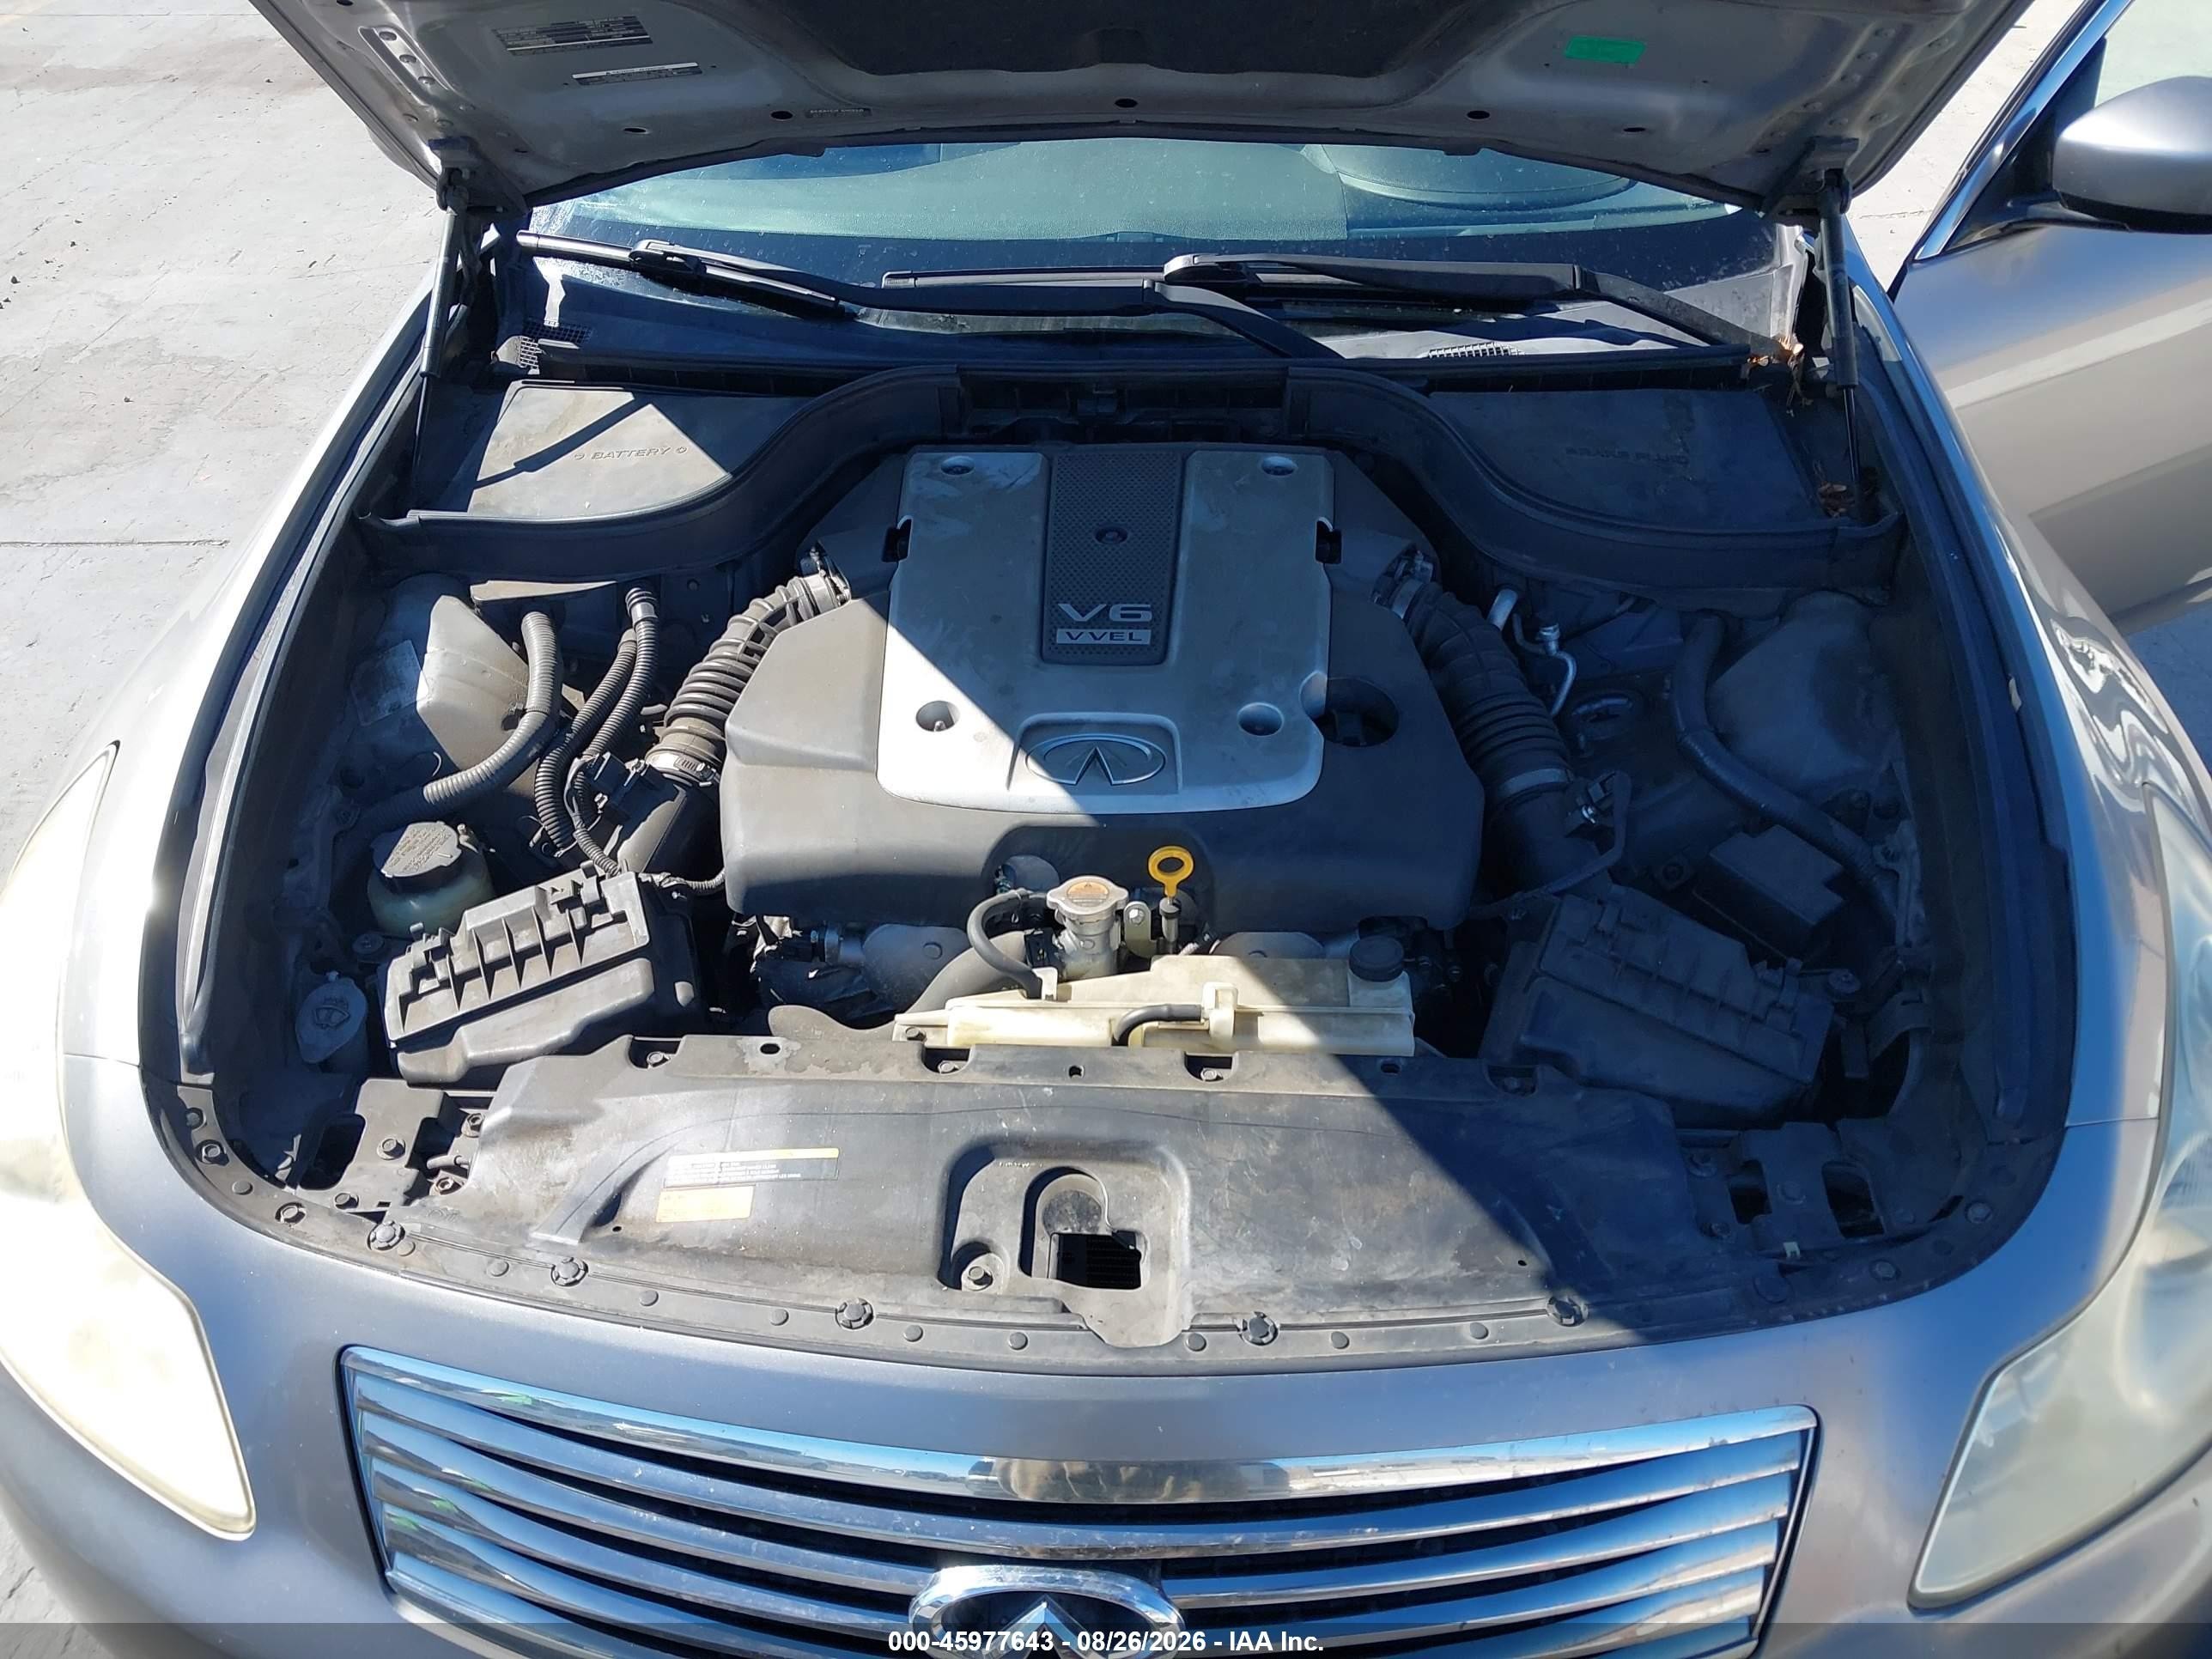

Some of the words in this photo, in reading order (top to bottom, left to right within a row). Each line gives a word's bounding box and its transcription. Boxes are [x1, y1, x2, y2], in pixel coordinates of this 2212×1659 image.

[591, 446, 672, 460] BATTERY
[1058, 603, 1152, 623] V6
[1066, 631, 1142, 641] VVEL
